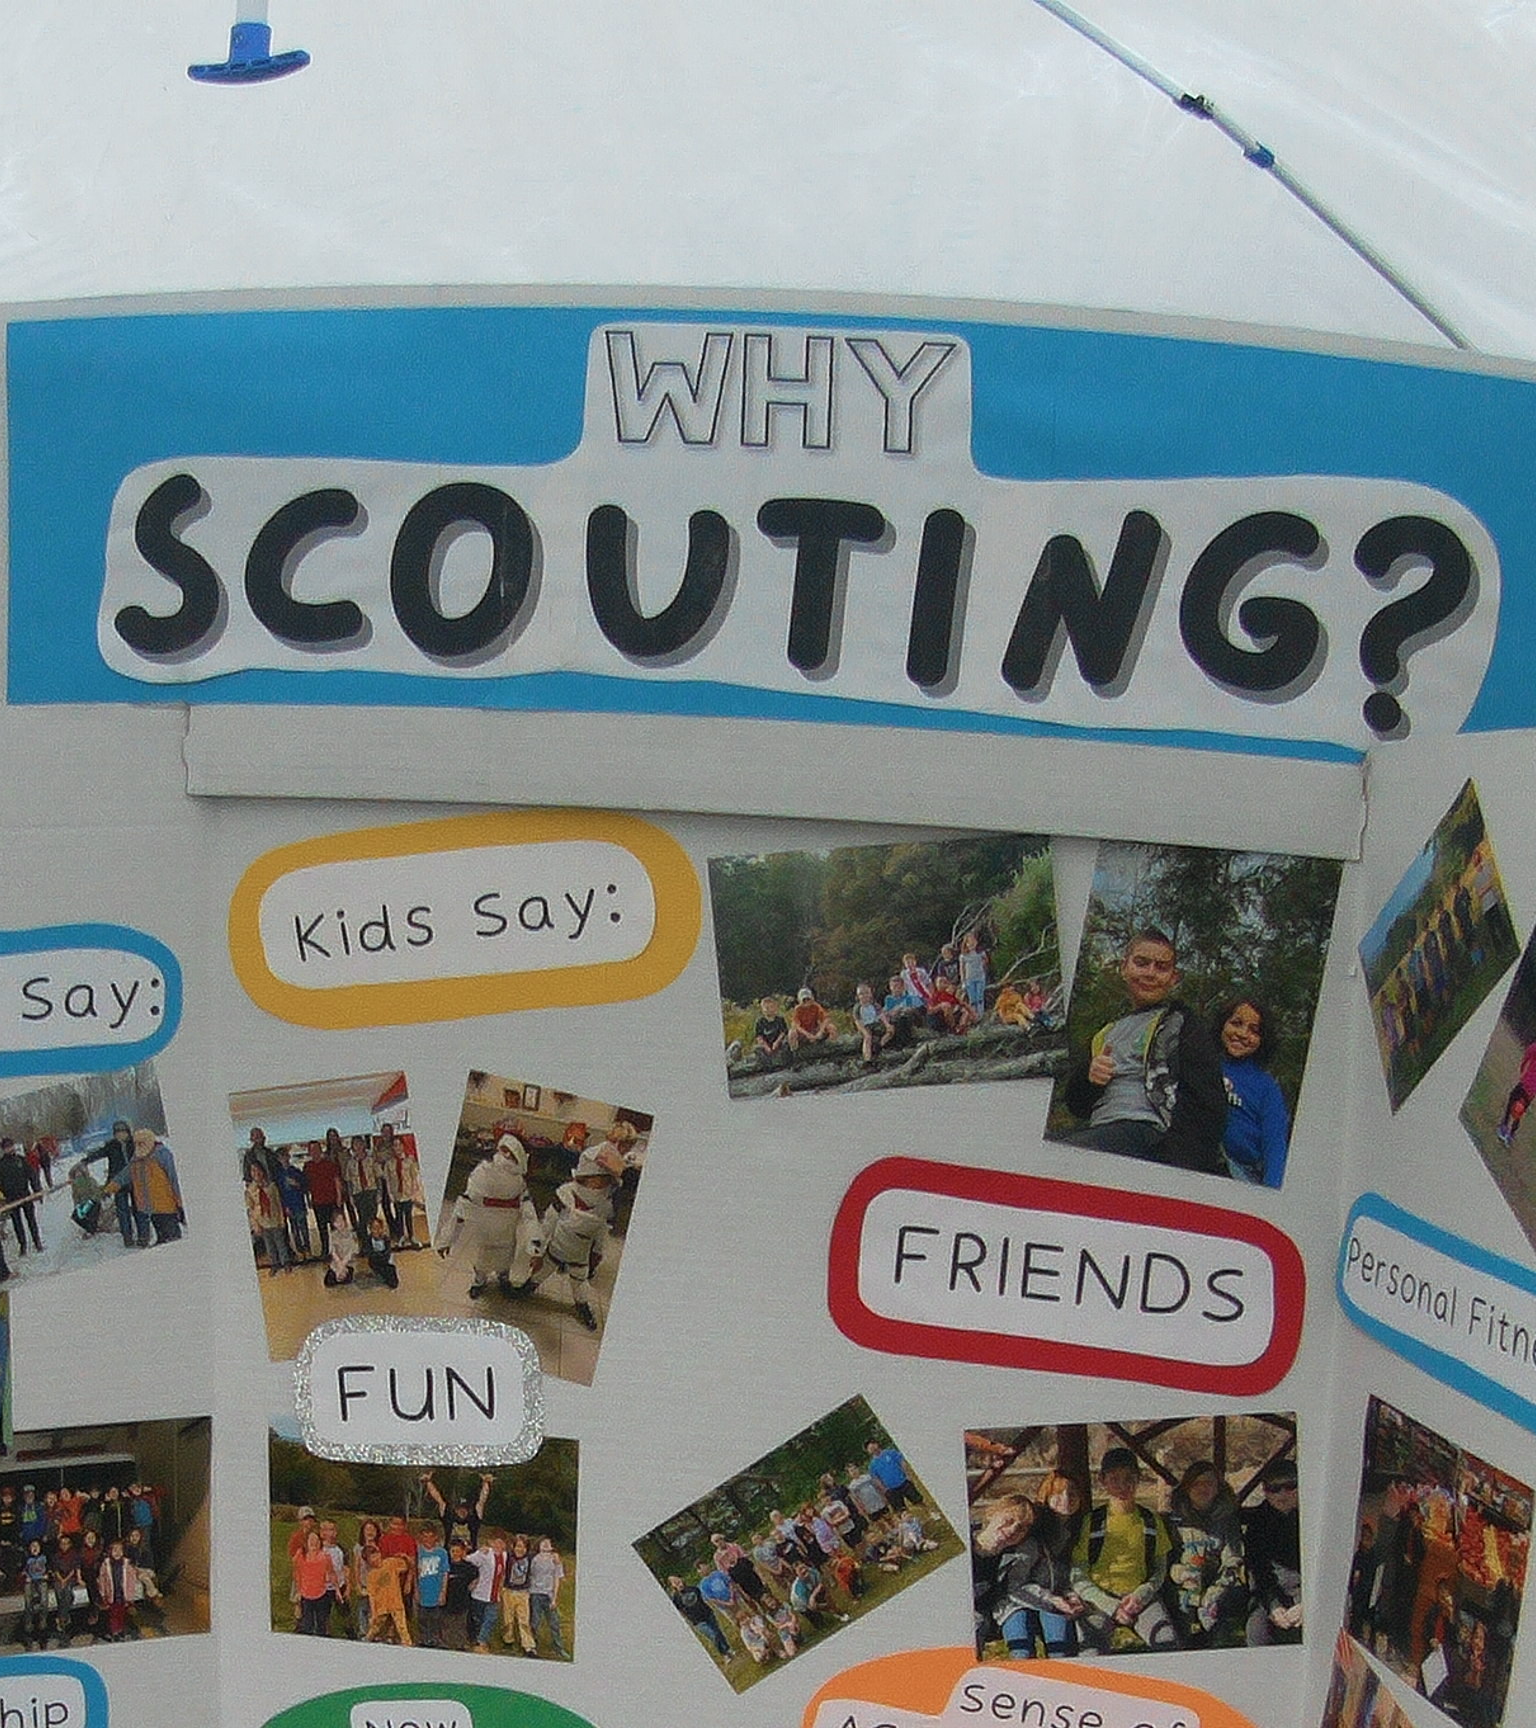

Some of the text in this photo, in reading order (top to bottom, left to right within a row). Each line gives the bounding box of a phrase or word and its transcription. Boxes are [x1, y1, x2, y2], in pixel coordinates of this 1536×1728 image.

[606, 330, 955, 455] WHY
[112, 472, 1476, 736] SCOUTING?
[294, 881, 625, 963] Kids Say:
[22, 974, 164, 1029] Say:
[893, 1225, 1247, 1324] FRIENDS
[1346, 1234, 1459, 1325] Personal
[336, 1364, 498, 1424] FUN
